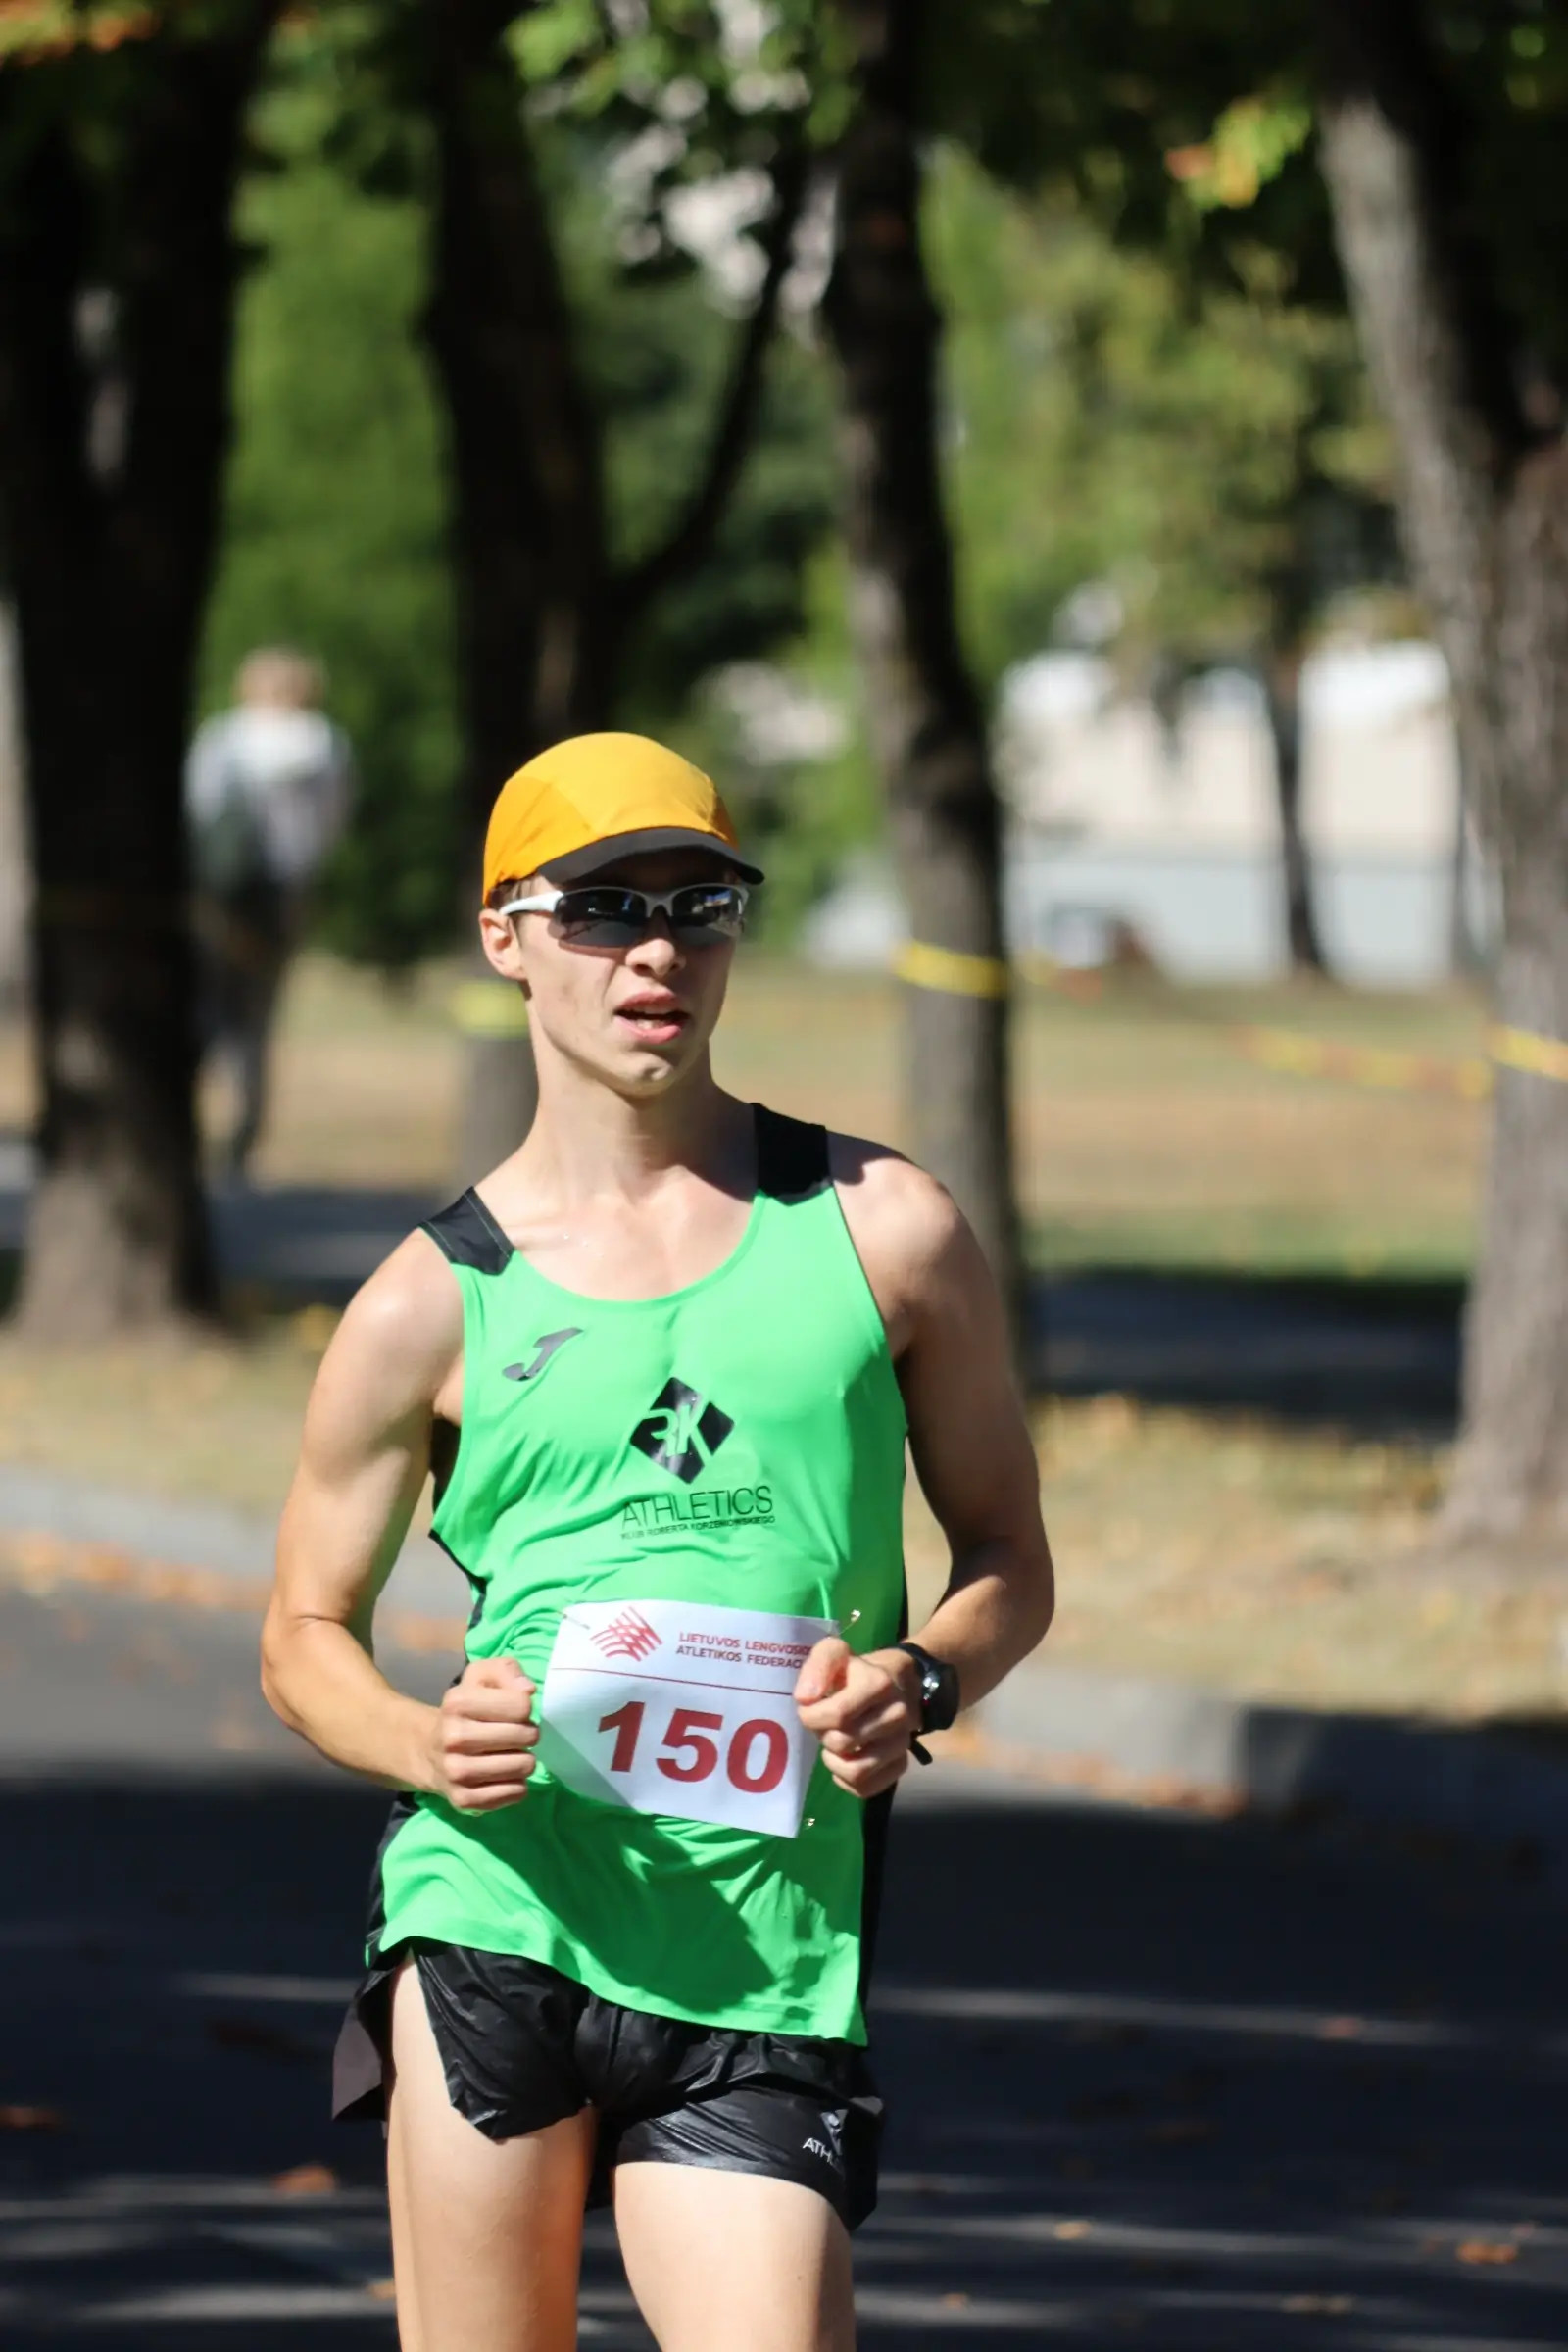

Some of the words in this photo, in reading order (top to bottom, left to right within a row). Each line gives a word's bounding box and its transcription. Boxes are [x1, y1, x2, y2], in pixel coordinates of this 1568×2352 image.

[621, 1486, 774, 1529] ATHLETICS
[676, 1645, 742, 1662] ATLETIKOS
[679, 1632, 741, 1648] LIETUVOS
[598, 1701, 789, 1793] 150
